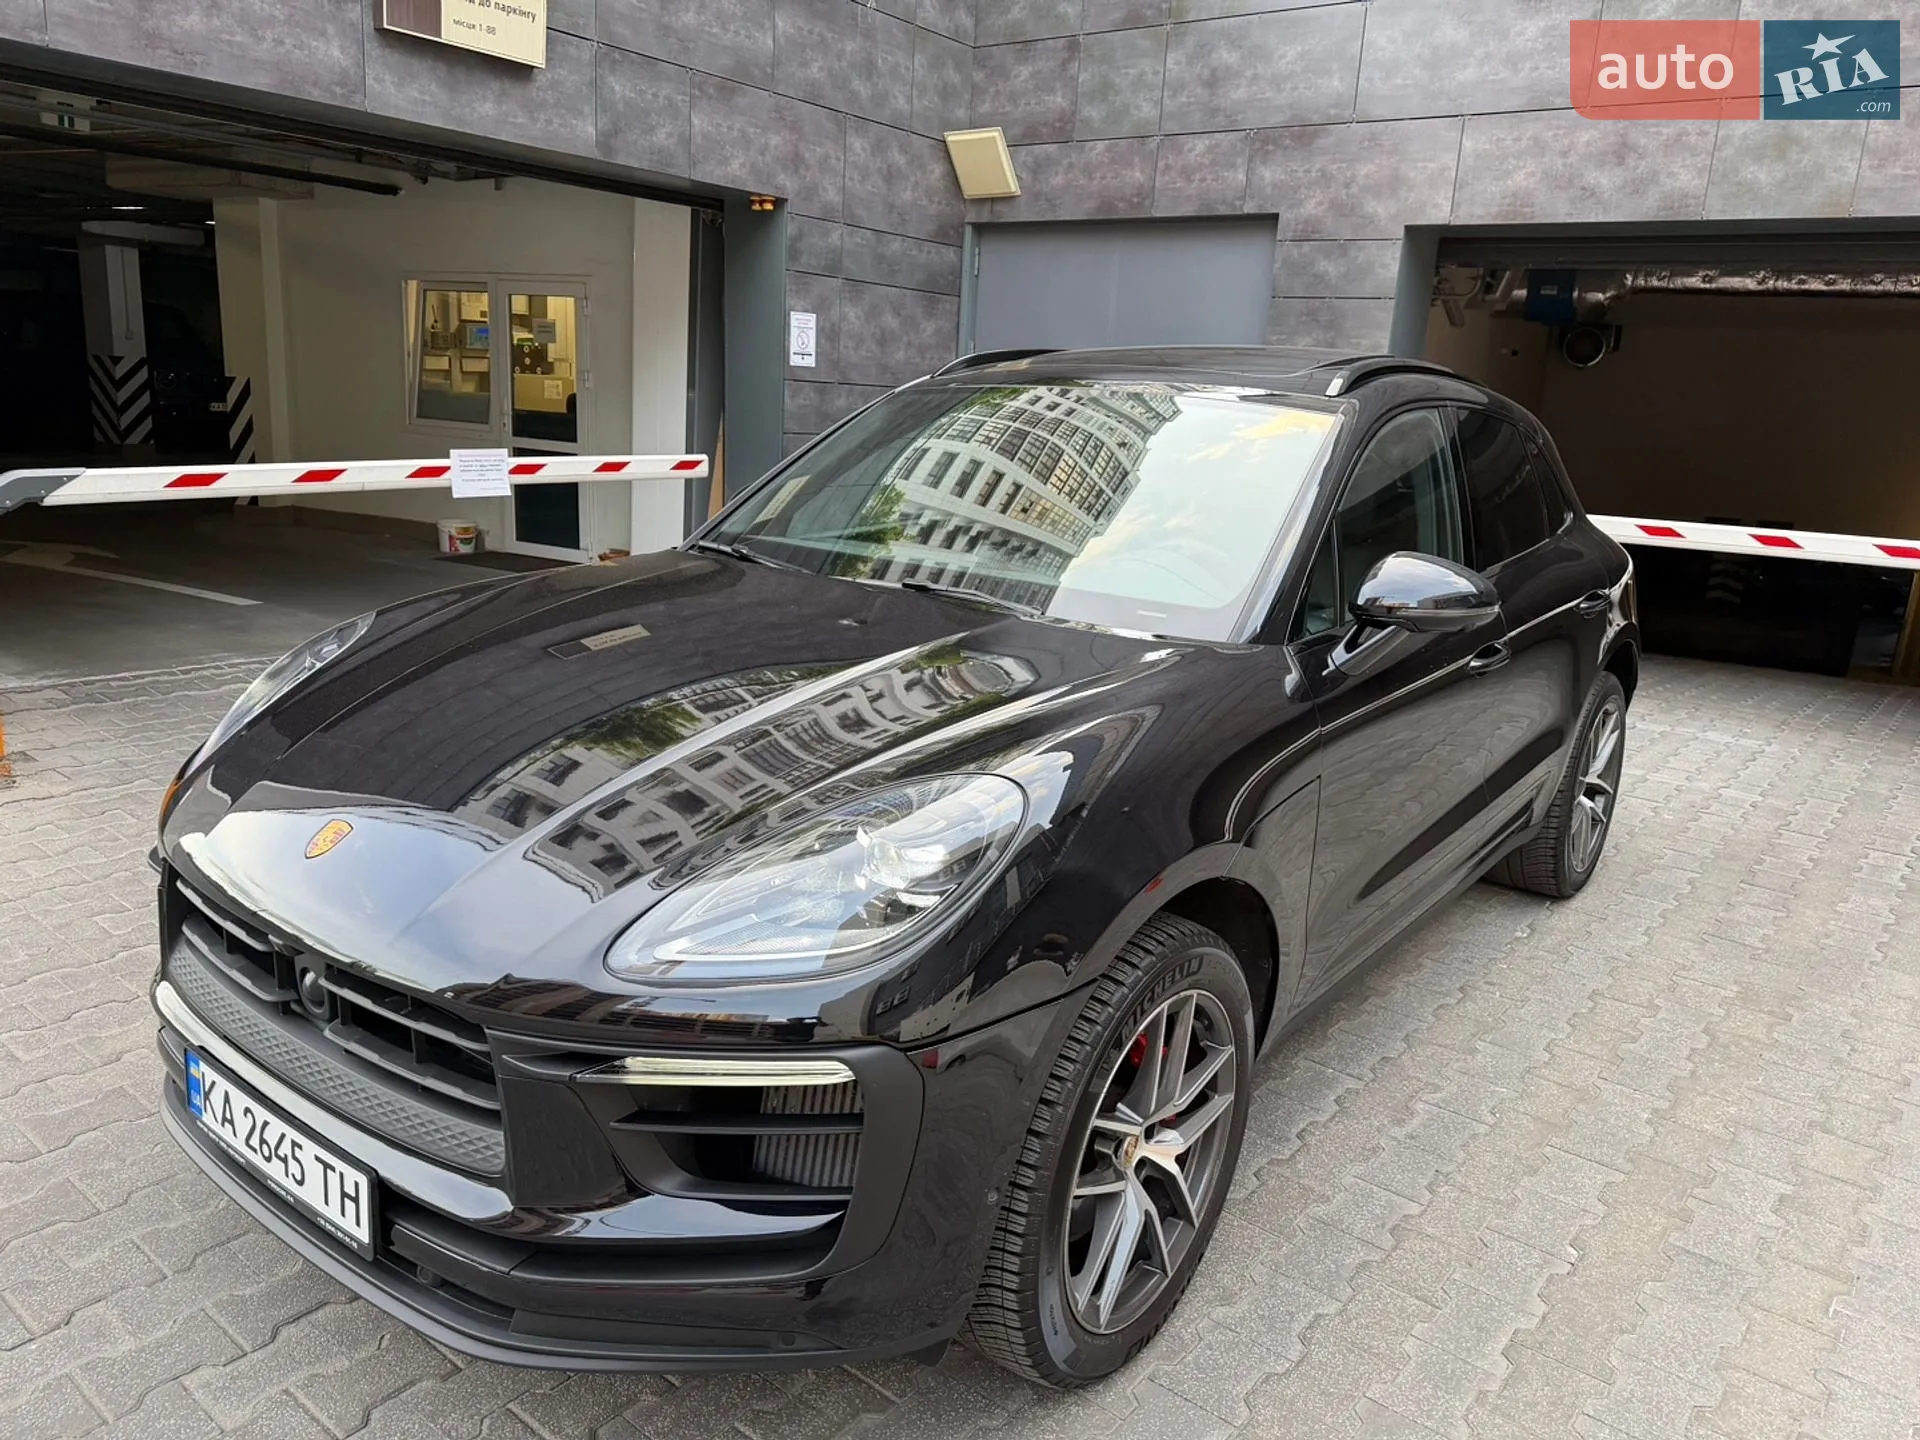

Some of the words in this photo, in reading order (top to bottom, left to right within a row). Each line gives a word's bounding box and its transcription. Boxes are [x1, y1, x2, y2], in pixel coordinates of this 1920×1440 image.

[494, 2, 536, 23] паркінгу
[202, 1071, 238, 1139] KA
[243, 1106, 306, 1188] 2645
[314, 1153, 362, 1229] TH
